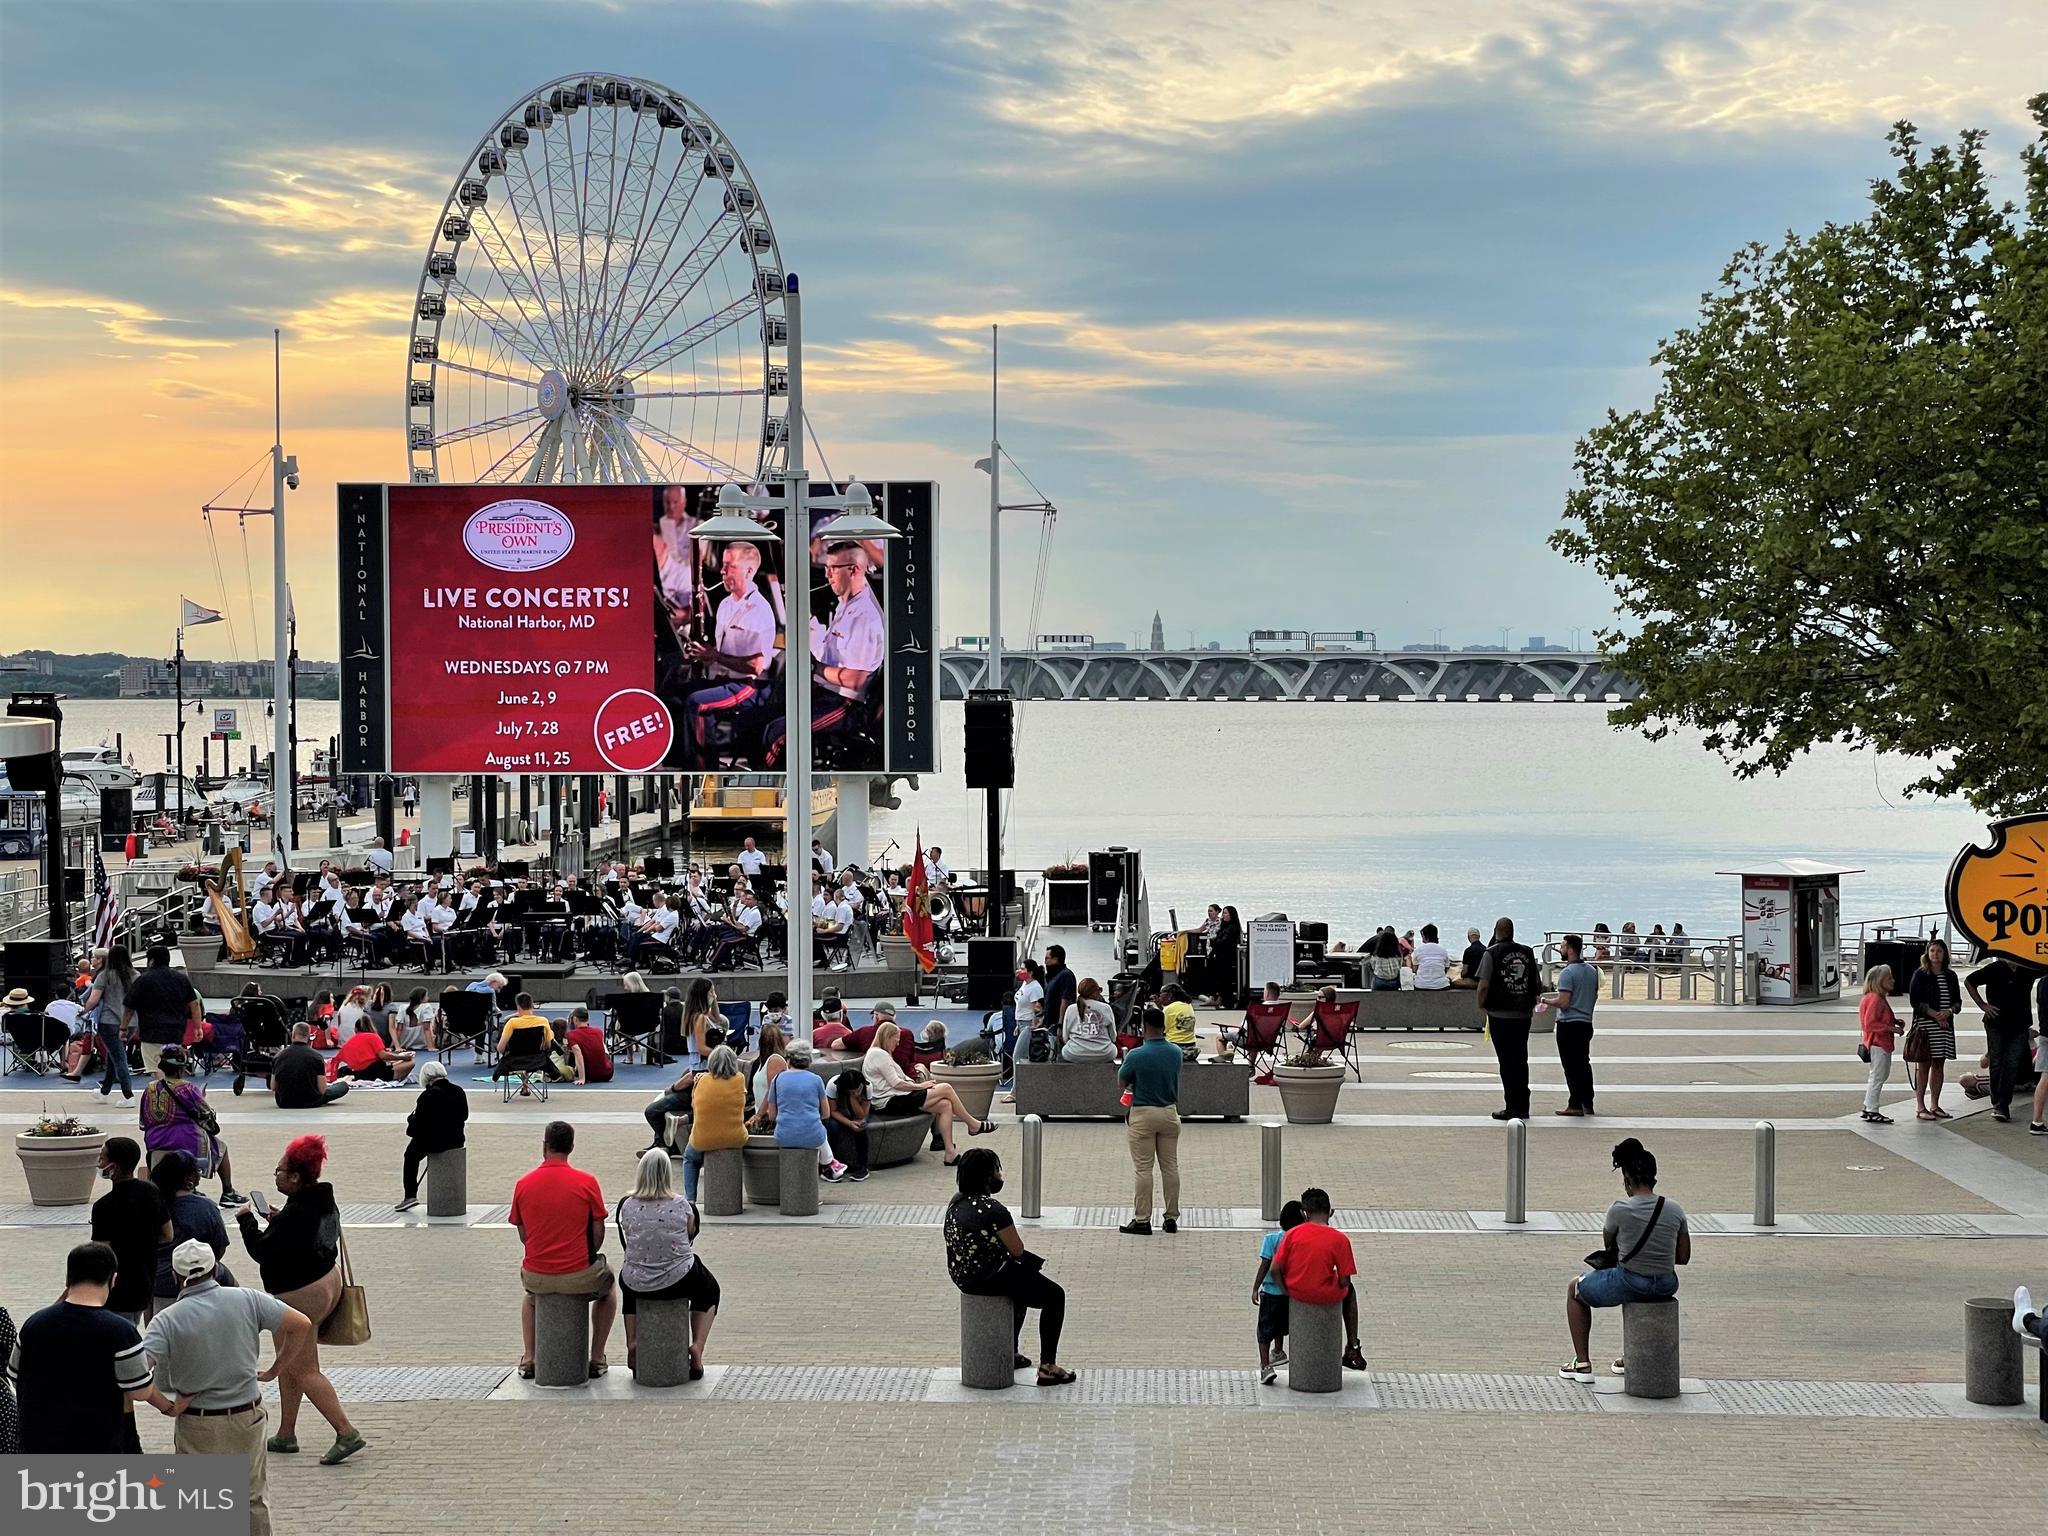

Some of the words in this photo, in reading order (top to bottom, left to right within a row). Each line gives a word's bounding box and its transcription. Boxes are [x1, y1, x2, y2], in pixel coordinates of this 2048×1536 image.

[476, 521, 562, 536] PRESIDENT'S
[502, 535, 537, 548] OWN
[357, 514, 367, 620] NATIONAL
[905, 507, 915, 615] NATIONAL
[424, 588, 477, 608] LIVE
[485, 588, 629, 608] CONCERTS!
[458, 615, 513, 629] National
[517, 615, 566, 632] Harbor,
[569, 615, 595, 629] MD
[445, 660, 551, 675] WEDNESDAYS
[554, 661, 571, 677] @
[574, 660, 582, 674] 7
[586, 660, 609, 674] PM
[497, 691, 529, 705] June
[531, 691, 545, 707] 2,
[548, 691, 557, 705] 9
[906, 666, 916, 742] HARBOR
[358, 671, 368, 747] HARBOR
[495, 721, 522, 740] July
[525, 721, 538, 738] 7,
[541, 721, 559, 735] 28
[603, 711, 665, 750] FREE!
[485, 751, 531, 770] August
[534, 751, 550, 767] 11,
[553, 751, 571, 765] 25
